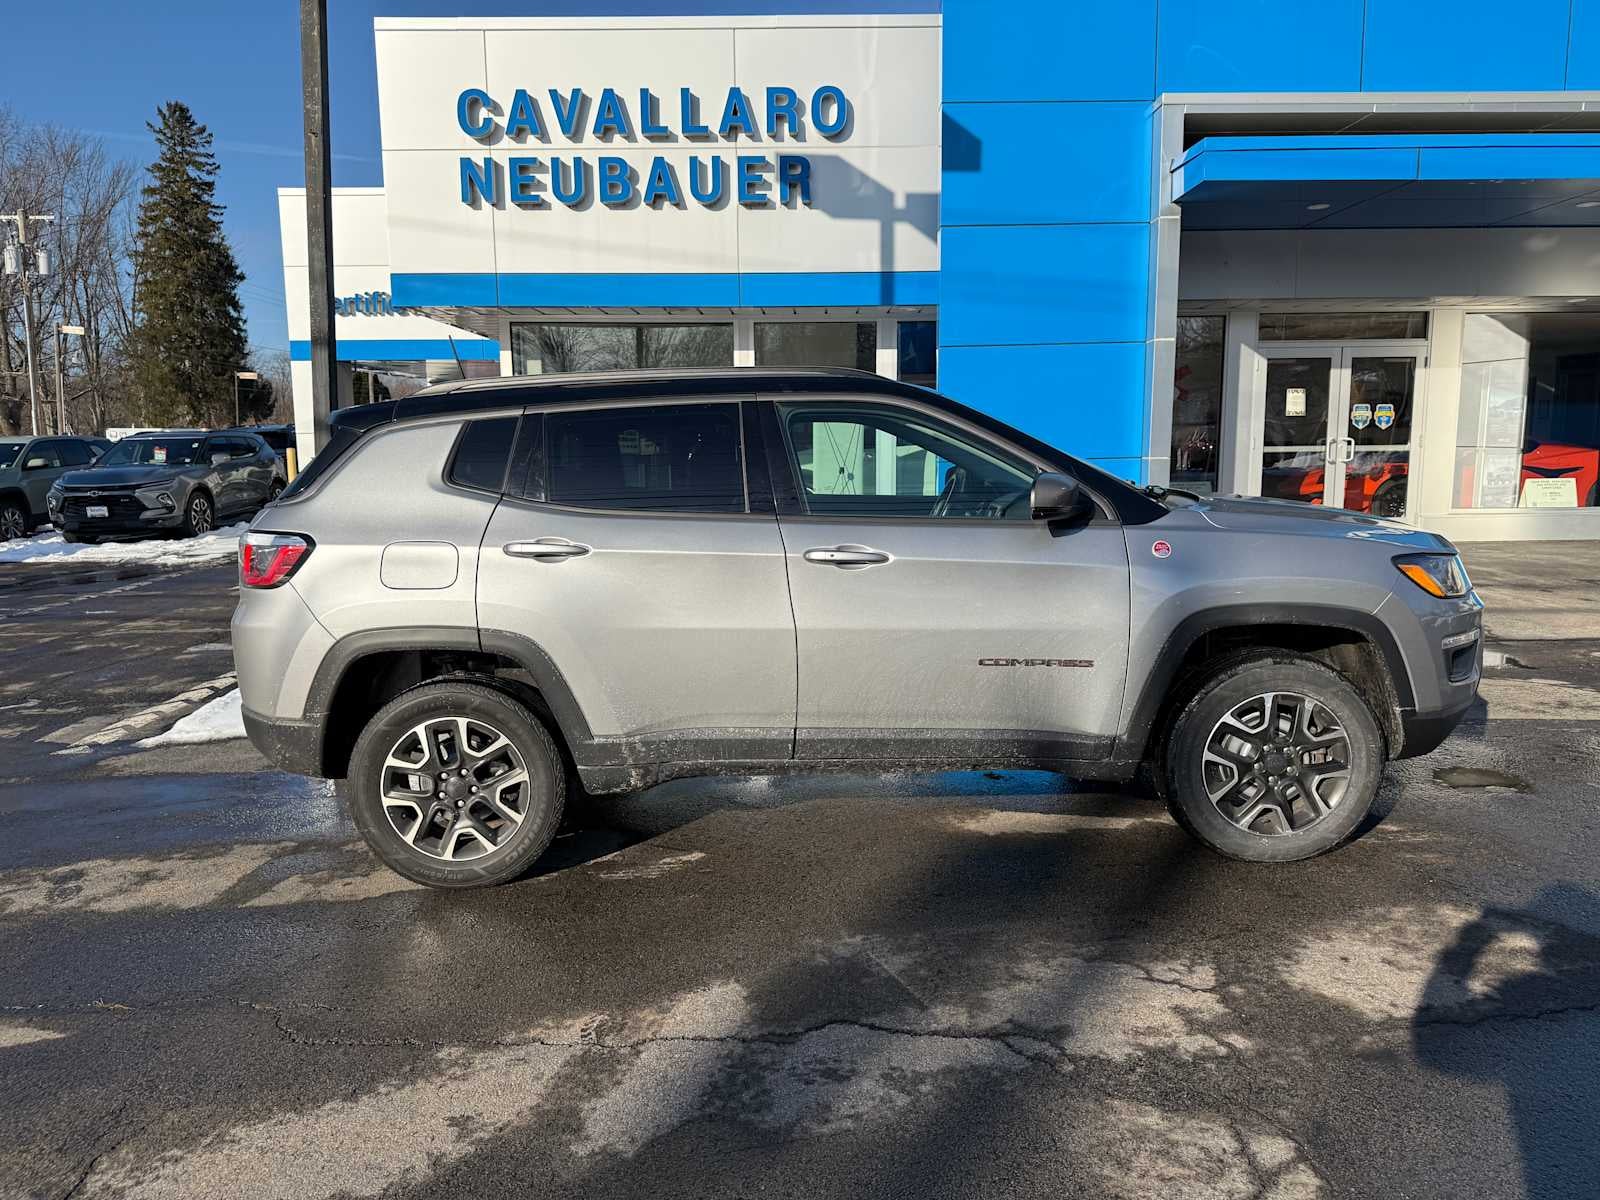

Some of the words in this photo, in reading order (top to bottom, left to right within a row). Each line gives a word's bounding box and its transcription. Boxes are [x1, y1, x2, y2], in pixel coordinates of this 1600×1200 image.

[457, 85, 848, 139] CAVALLARO
[459, 154, 813, 206] NEUBAUER
[978, 658, 1095, 668] COMPASS
